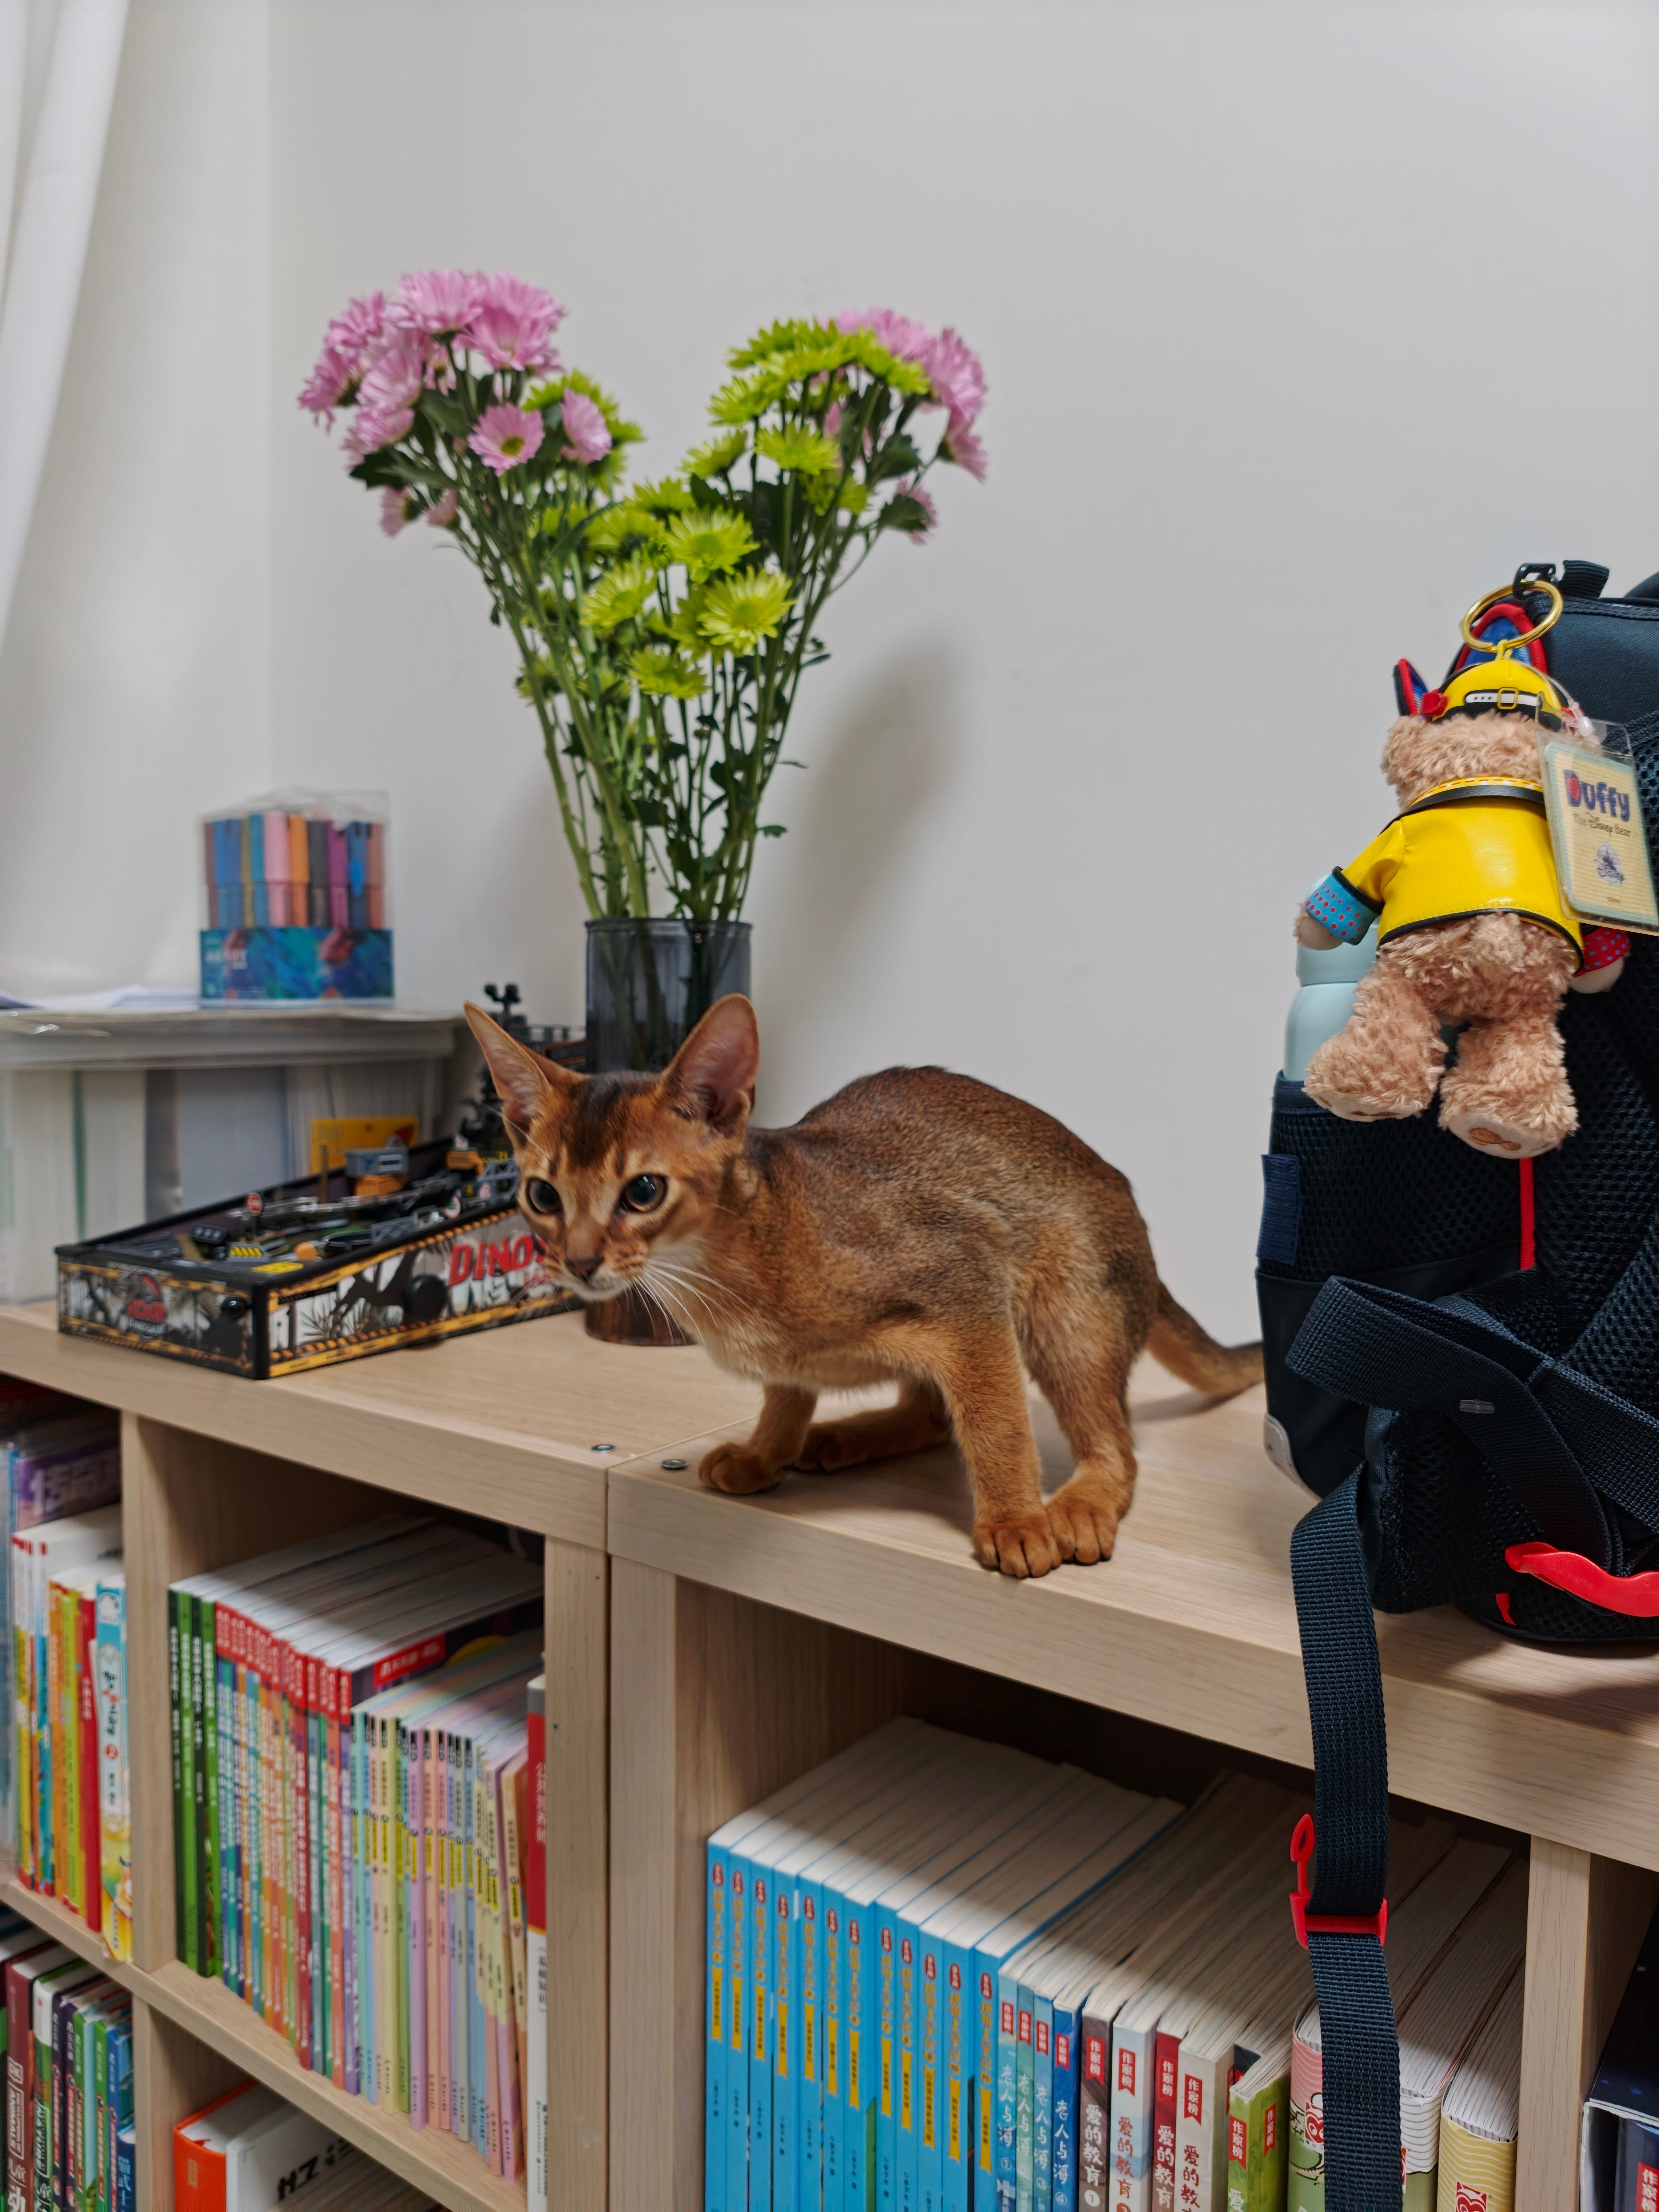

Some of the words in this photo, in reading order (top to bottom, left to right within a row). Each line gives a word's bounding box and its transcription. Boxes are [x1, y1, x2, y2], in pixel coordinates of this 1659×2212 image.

[1563, 769, 1630, 822] Duffy
[1090, 2040, 1100, 2075] 作家榜
[1122, 2052, 1132, 2088] 作家榜
[1162, 2061, 1173, 2096] 作家榜
[998, 2065, 1013, 2148] 老人与海
[1016, 2074, 1030, 2156] 老人与海
[1033, 2085, 1049, 2169] 老人与海
[1188, 2079, 1198, 2115] 作家榜
[1053, 2099, 1069, 2185] 老人与海
[1083, 2104, 1103, 2186] 爱的教育
[1115, 2116, 1134, 2200] 爱的教育
[1155, 2125, 1175, 2209] 爱的教育
[1233, 2121, 1243, 2159] 作家榜
[1180, 2145, 1201, 2212] 爱的教
